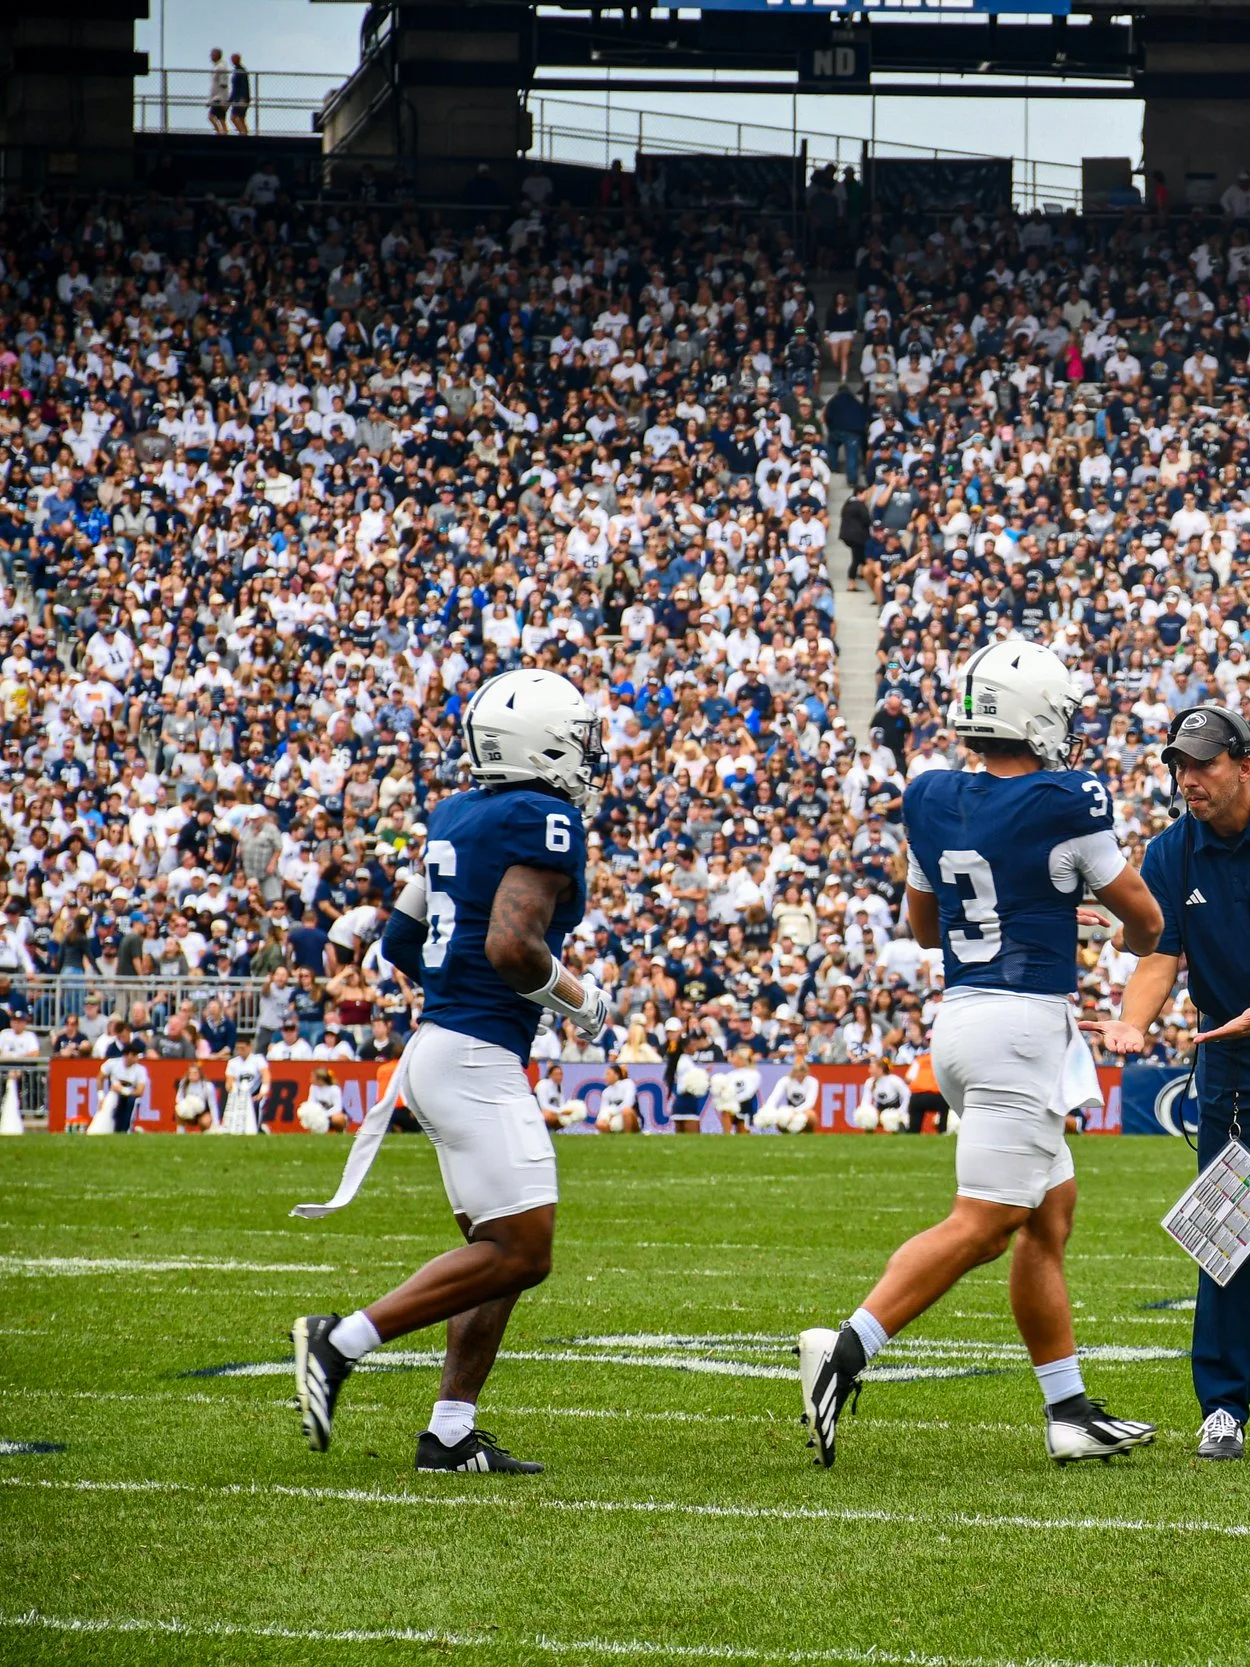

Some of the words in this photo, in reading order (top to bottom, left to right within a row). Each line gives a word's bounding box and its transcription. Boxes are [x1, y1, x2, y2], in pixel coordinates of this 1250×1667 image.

[812, 47, 856, 77] ND
[1082, 780, 1108, 818] 3
[545, 813, 571, 852] 6
[422, 840, 457, 967] 6
[938, 850, 1002, 963] 3
